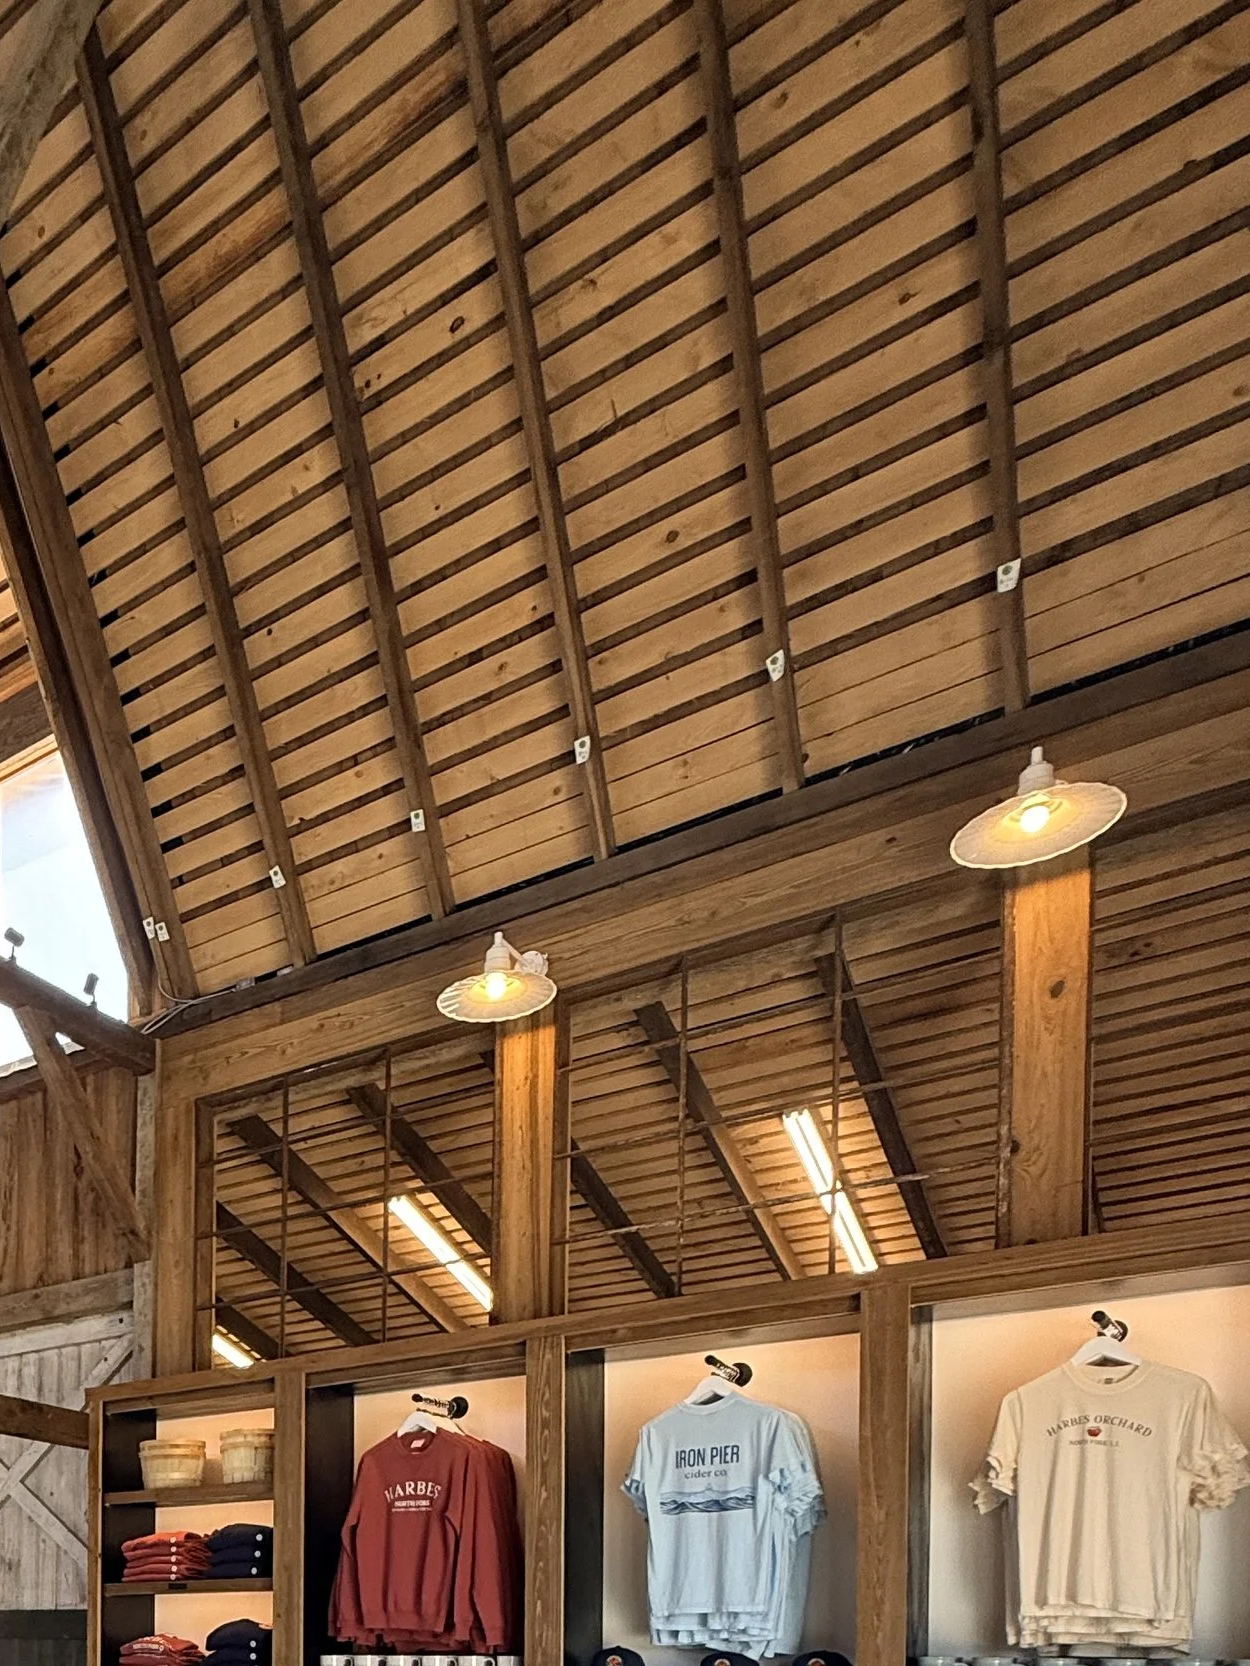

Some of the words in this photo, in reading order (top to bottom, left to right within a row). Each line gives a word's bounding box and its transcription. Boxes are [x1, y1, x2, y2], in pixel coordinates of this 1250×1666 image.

[1046, 1415, 1090, 1437] HARBES
[1093, 1415, 1152, 1437] ORCHARD
[675, 1448, 705, 1469] IRON
[710, 1444, 739, 1465] PIER
[684, 1469, 712, 1480] cider
[384, 1481, 442, 1502] HARBES
